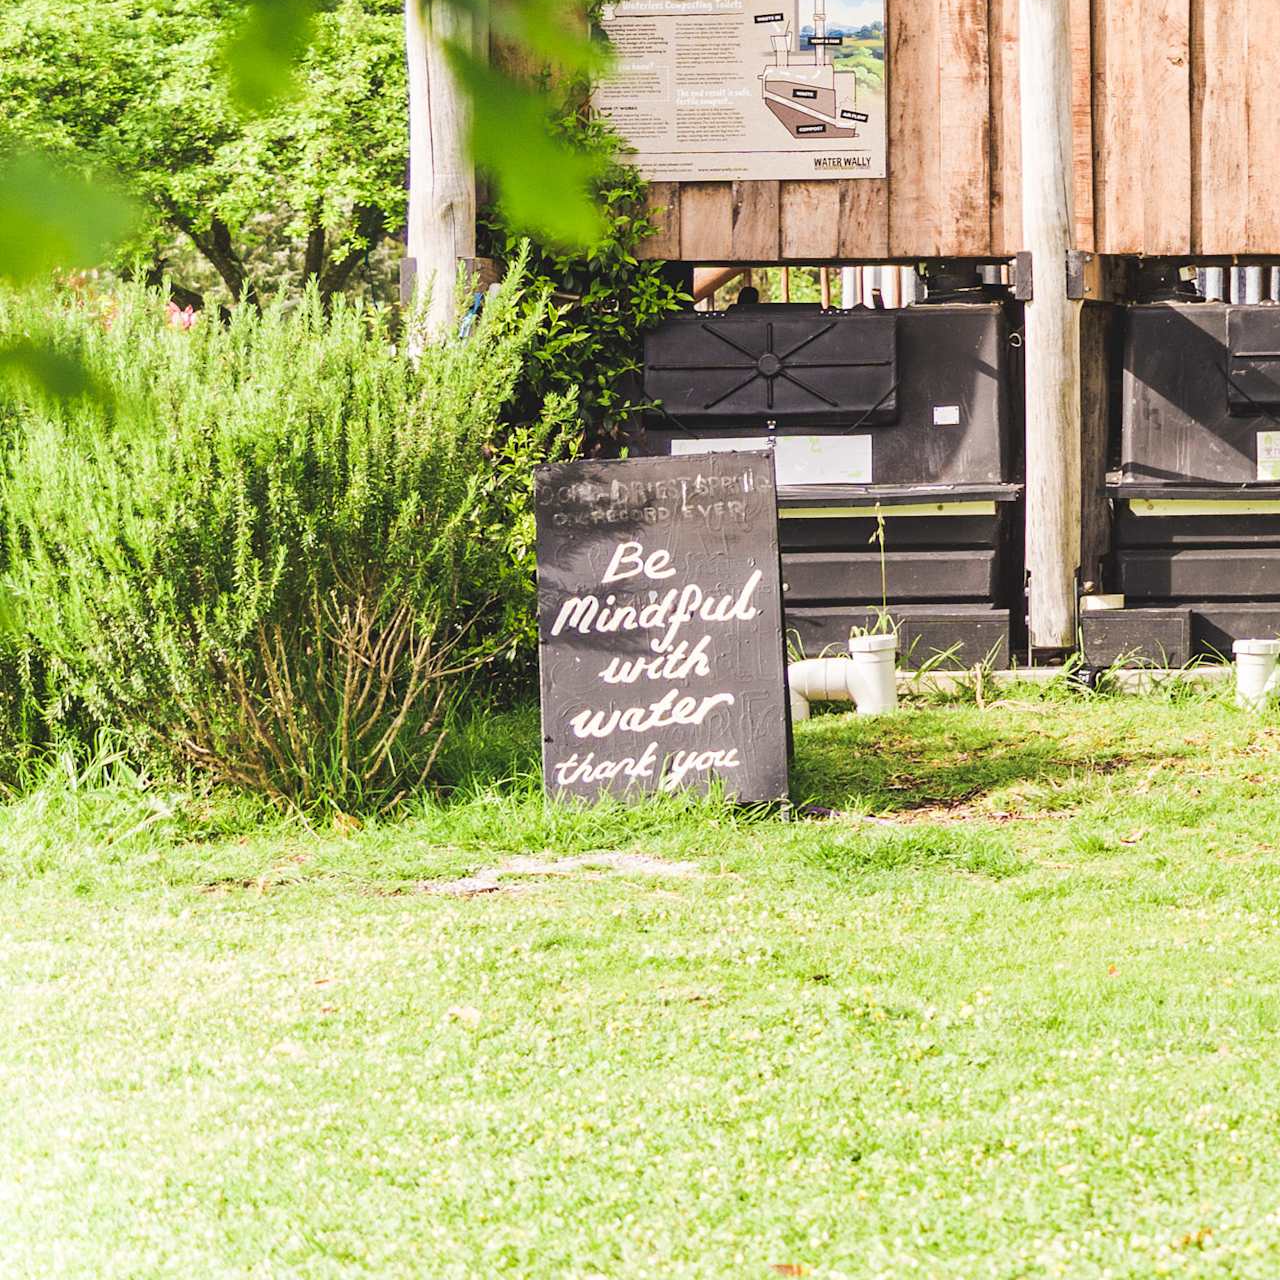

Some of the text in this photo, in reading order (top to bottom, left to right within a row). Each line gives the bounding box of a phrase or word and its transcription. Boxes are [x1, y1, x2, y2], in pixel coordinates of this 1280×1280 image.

[814, 156, 871, 167] WATER WALLY
[602, 541, 677, 584] Be
[551, 569, 763, 653] Mindful
[599, 635, 712, 684] with
[570, 688, 735, 741] water
[554, 741, 741, 791] thank you
